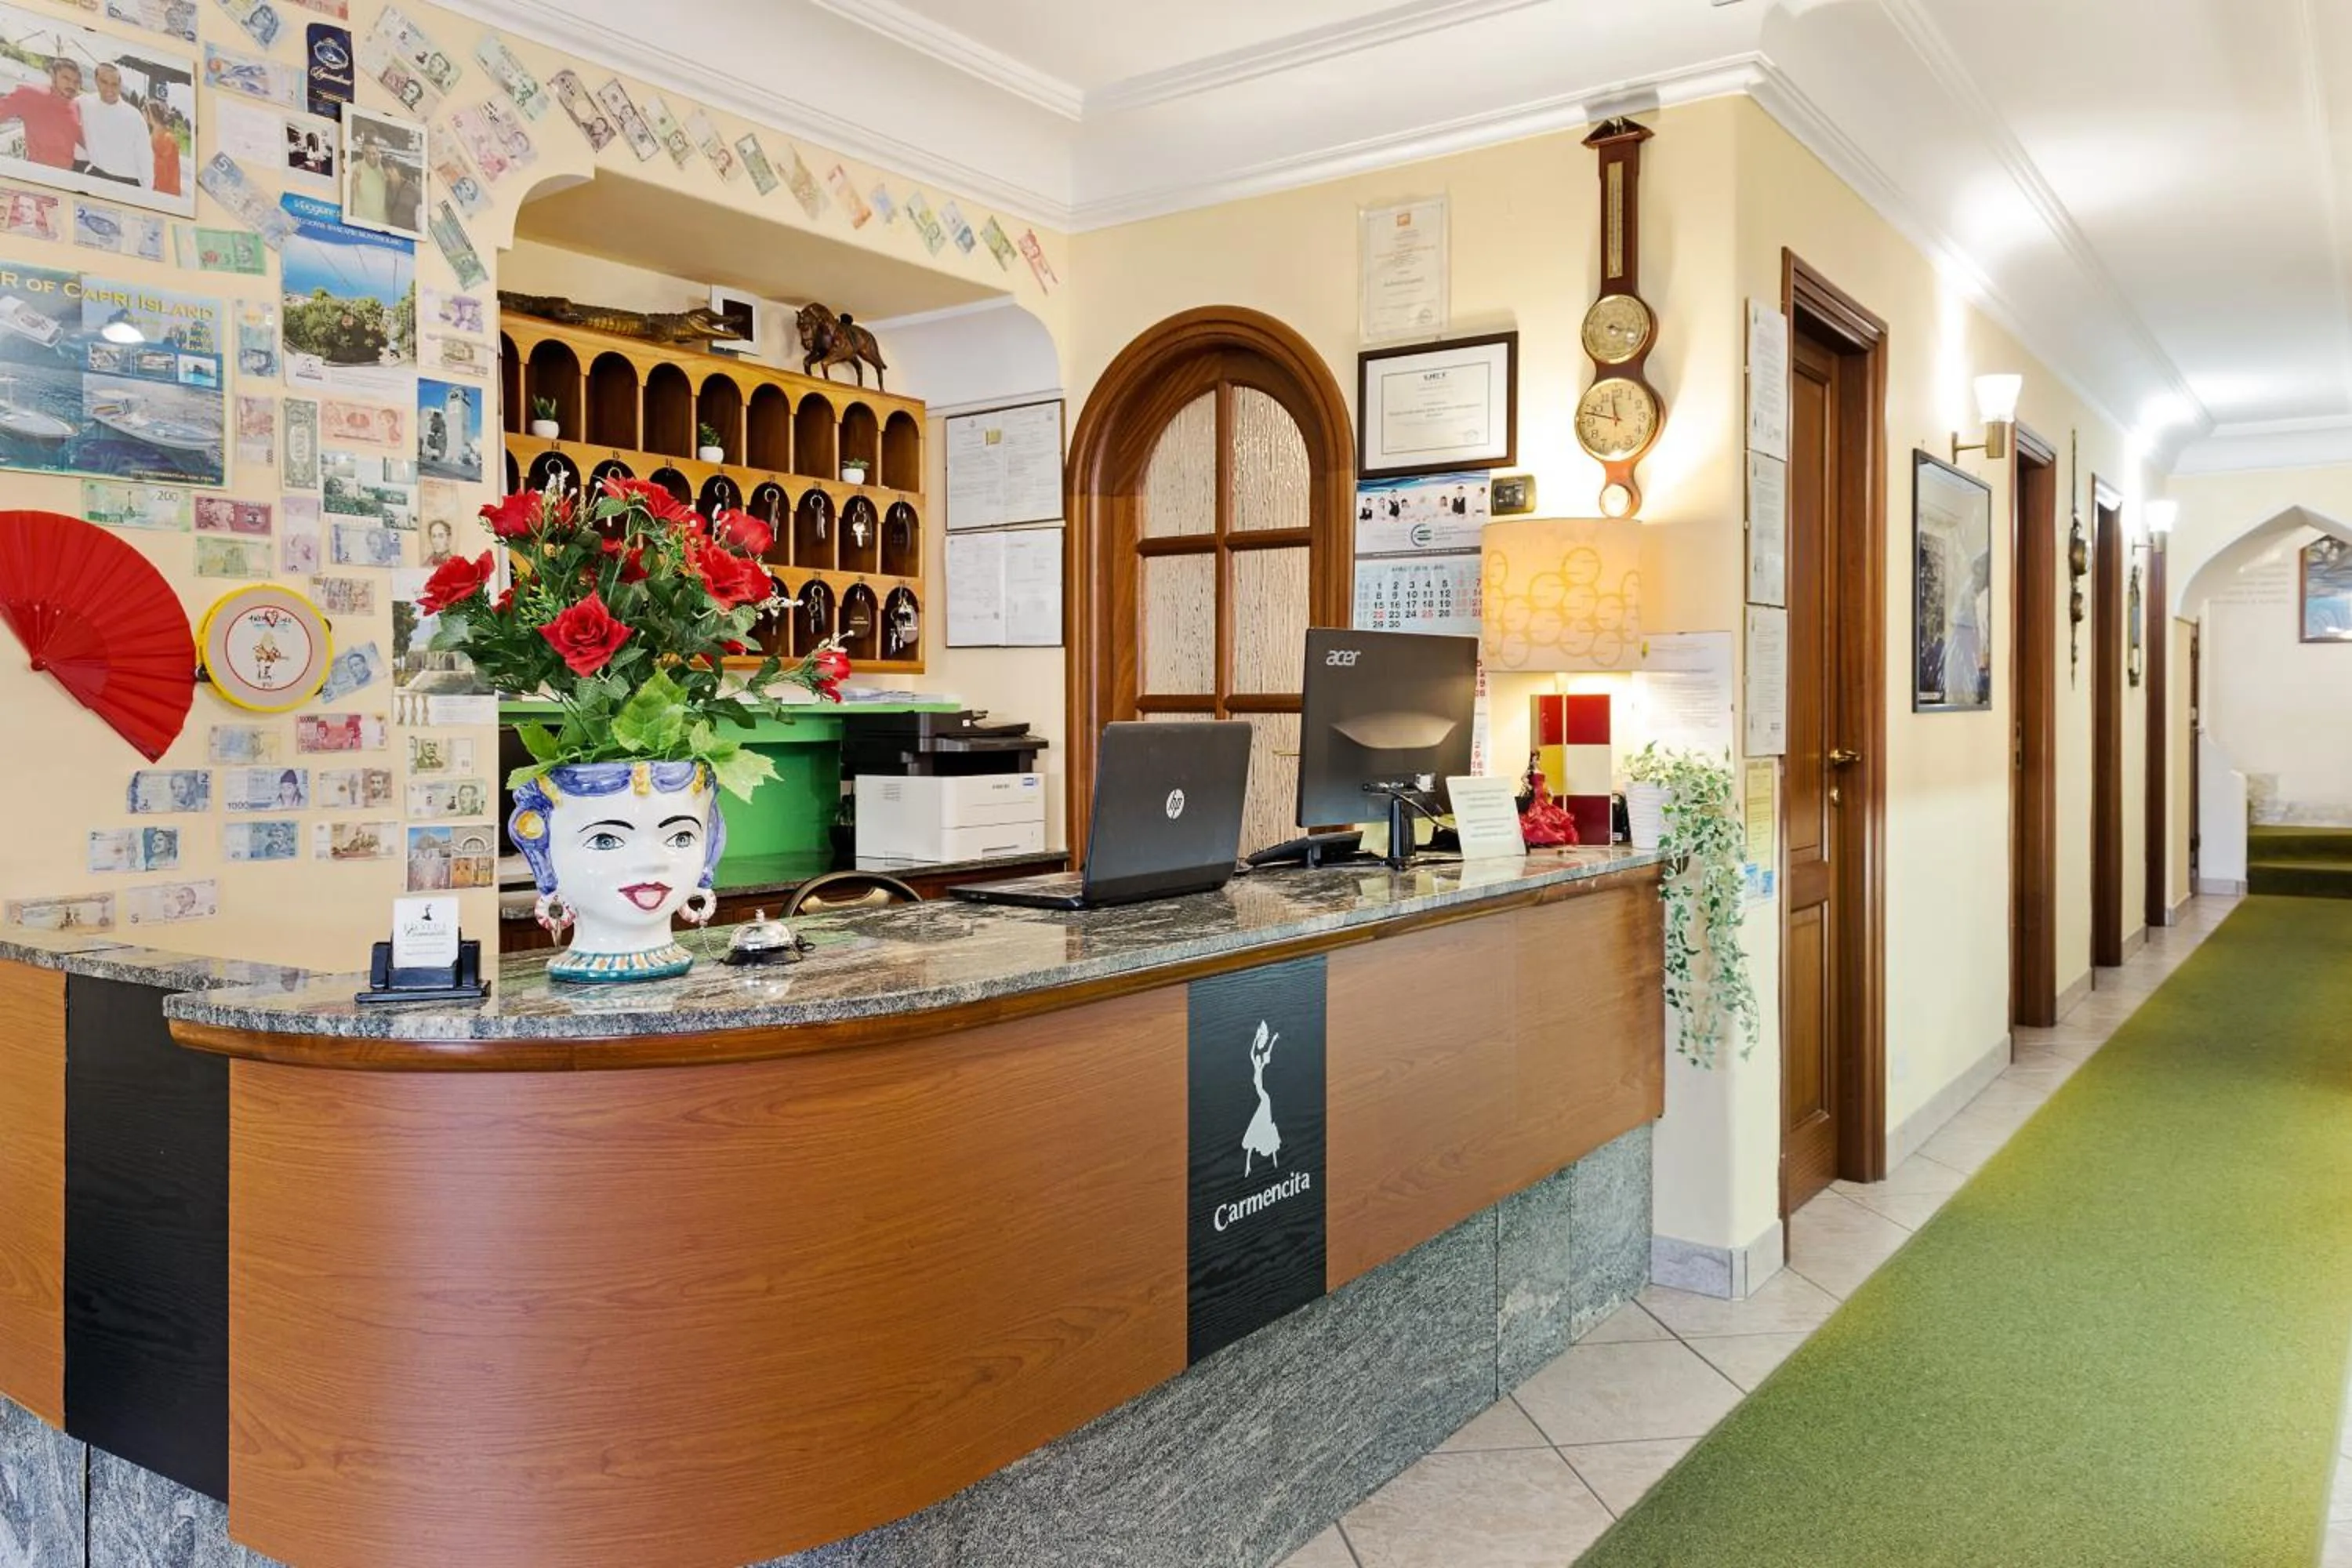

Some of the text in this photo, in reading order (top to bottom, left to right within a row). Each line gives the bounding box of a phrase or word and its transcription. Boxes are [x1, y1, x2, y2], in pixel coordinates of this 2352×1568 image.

[26, 278, 56, 293] OF
[64, 282, 132, 309] CAPRI
[139, 294, 213, 321] ISLAND
[1591, 429, 1599, 438] 8
[157, 490, 179, 502] 200
[1393, 581, 1399, 590] 2
[1406, 590, 1417, 599] 10
[1439, 590, 1450, 598] 12
[1405, 610, 1417, 619] 24
[1326, 650, 1361, 666] acer
[200, 773, 209, 783] 2
[228, 801, 250, 810] 1000
[1214, 1171, 1311, 1232] Carmencita
